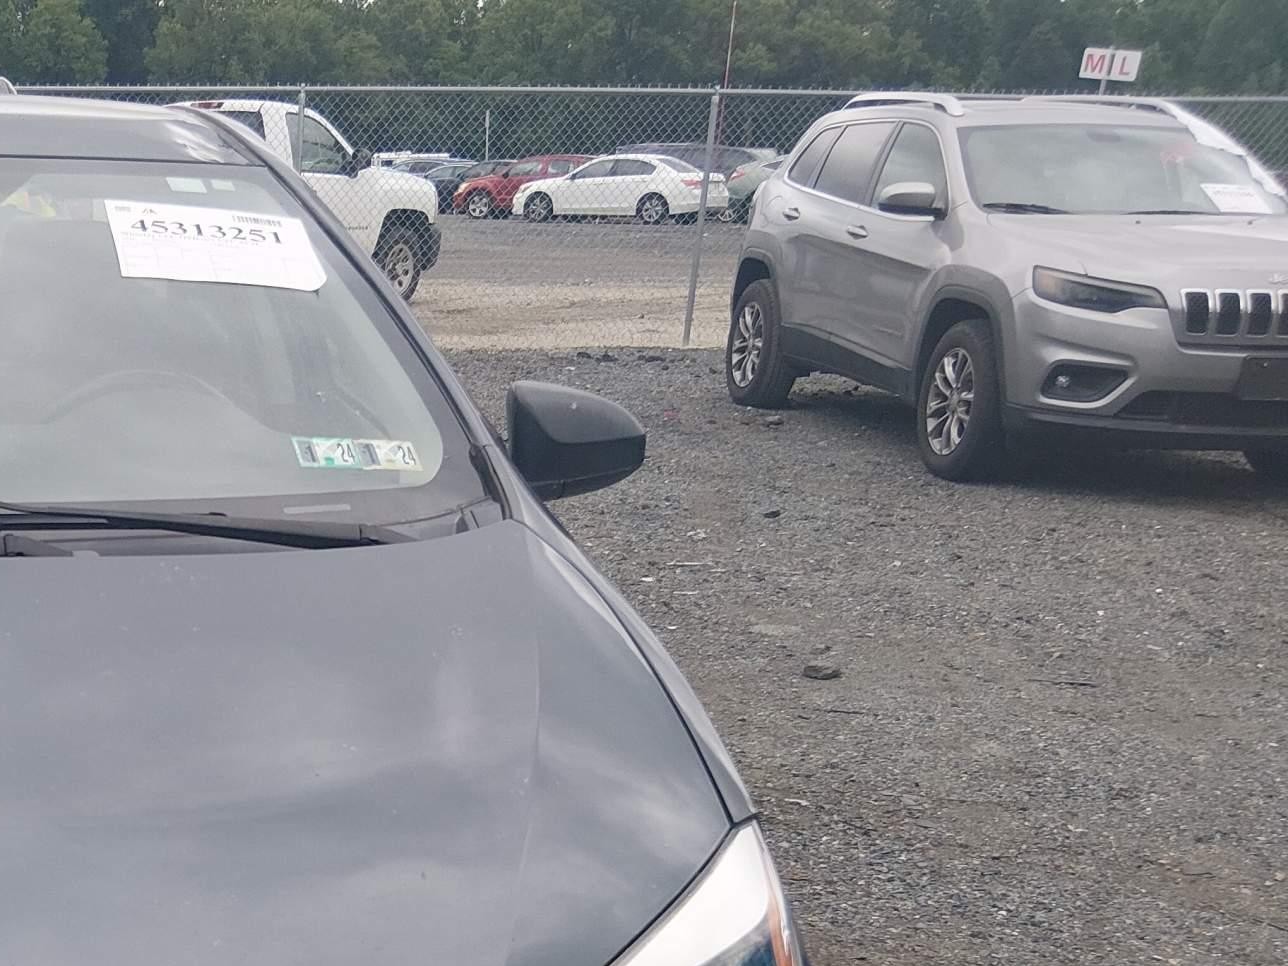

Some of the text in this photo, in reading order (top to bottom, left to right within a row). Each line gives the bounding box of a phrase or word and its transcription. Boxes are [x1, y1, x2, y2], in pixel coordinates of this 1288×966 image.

[1084, 53, 1130, 76] M L
[130, 218, 283, 245] 45313251
